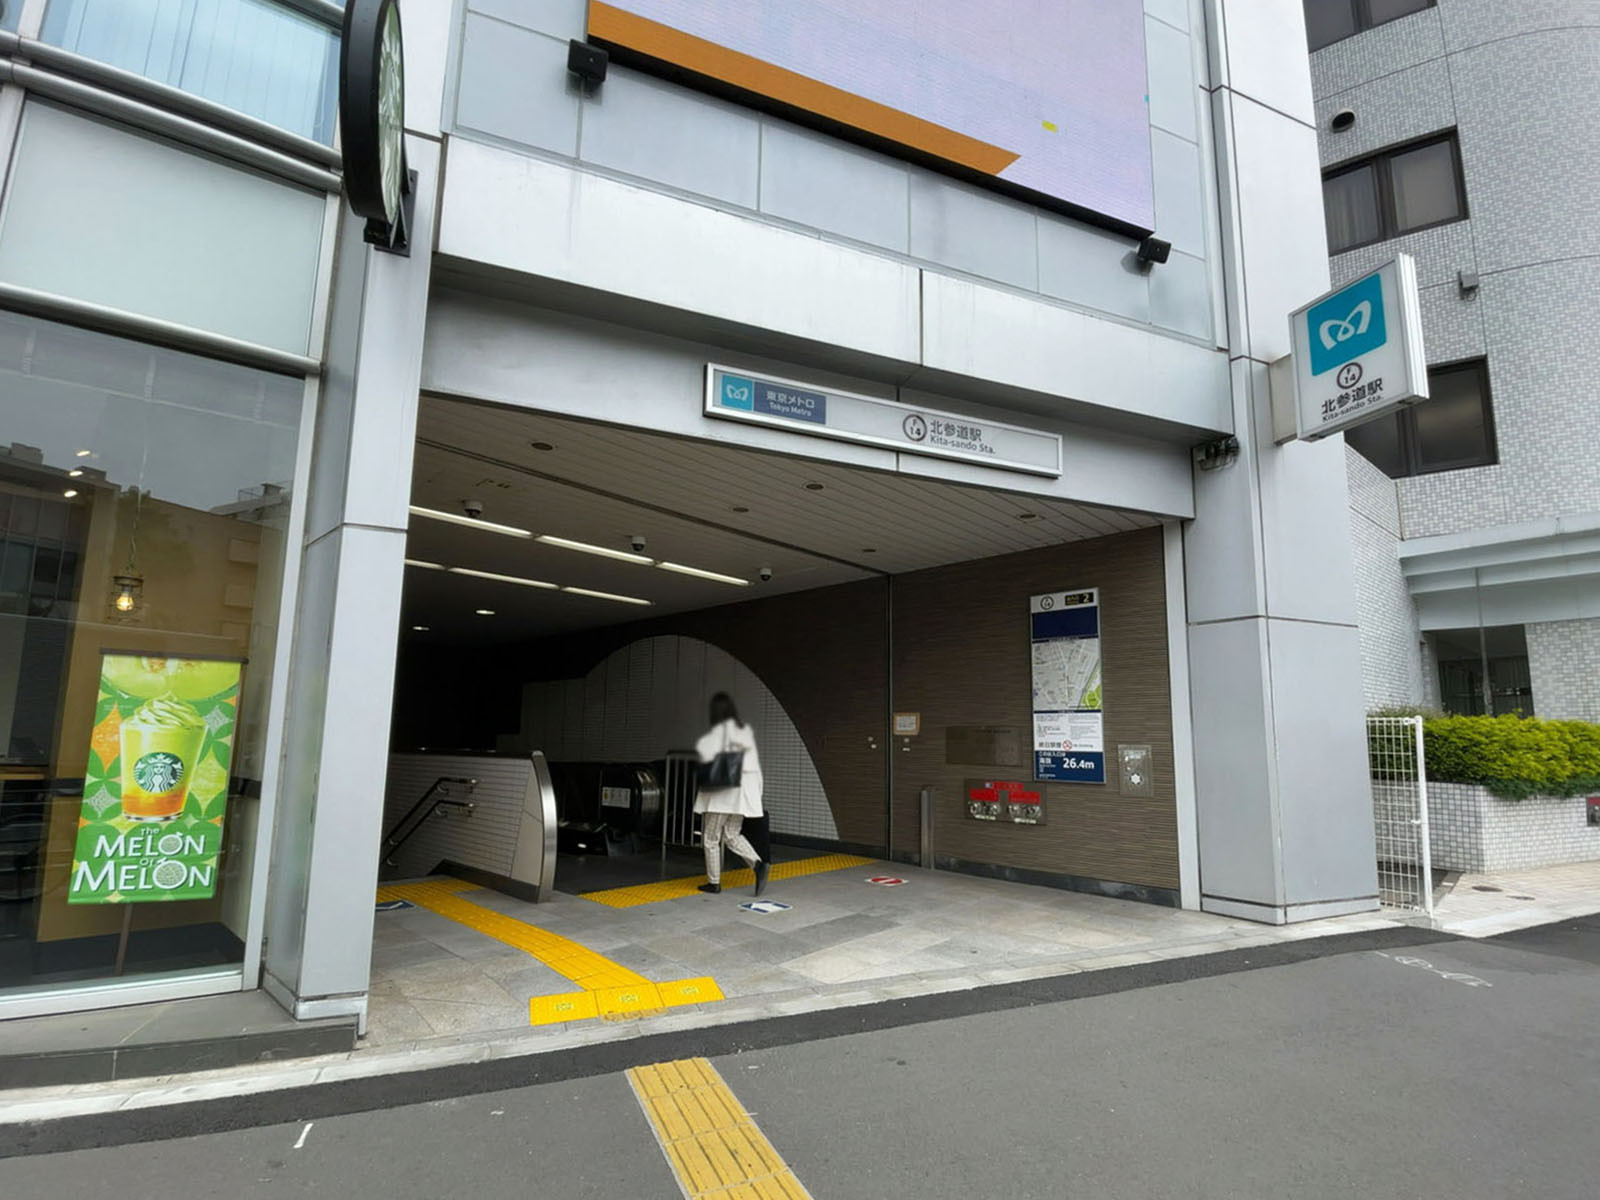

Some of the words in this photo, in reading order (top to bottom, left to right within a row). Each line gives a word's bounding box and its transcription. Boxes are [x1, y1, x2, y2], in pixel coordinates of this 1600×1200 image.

[1344, 373, 1356, 384] 14
[766, 390, 815, 409] 東京メトロ
[1321, 377, 1384, 415] 北参道駅
[769, 401, 790, 414] Tokyo
[790, 405, 812, 417] Metro
[1322, 401, 1366, 422] Kita-sando
[1367, 394, 1384, 405] Sta.
[910, 426, 922, 436] 14
[930, 420, 982, 442] 北参道駅
[930, 434, 978, 451] Kita-sando
[979, 443, 996, 455] Sta.
[1082, 593, 1090, 603] 2
[1063, 757, 1095, 769] 26.4m
[93, 832, 205, 858] MELON
[72, 858, 212, 892] MELON
